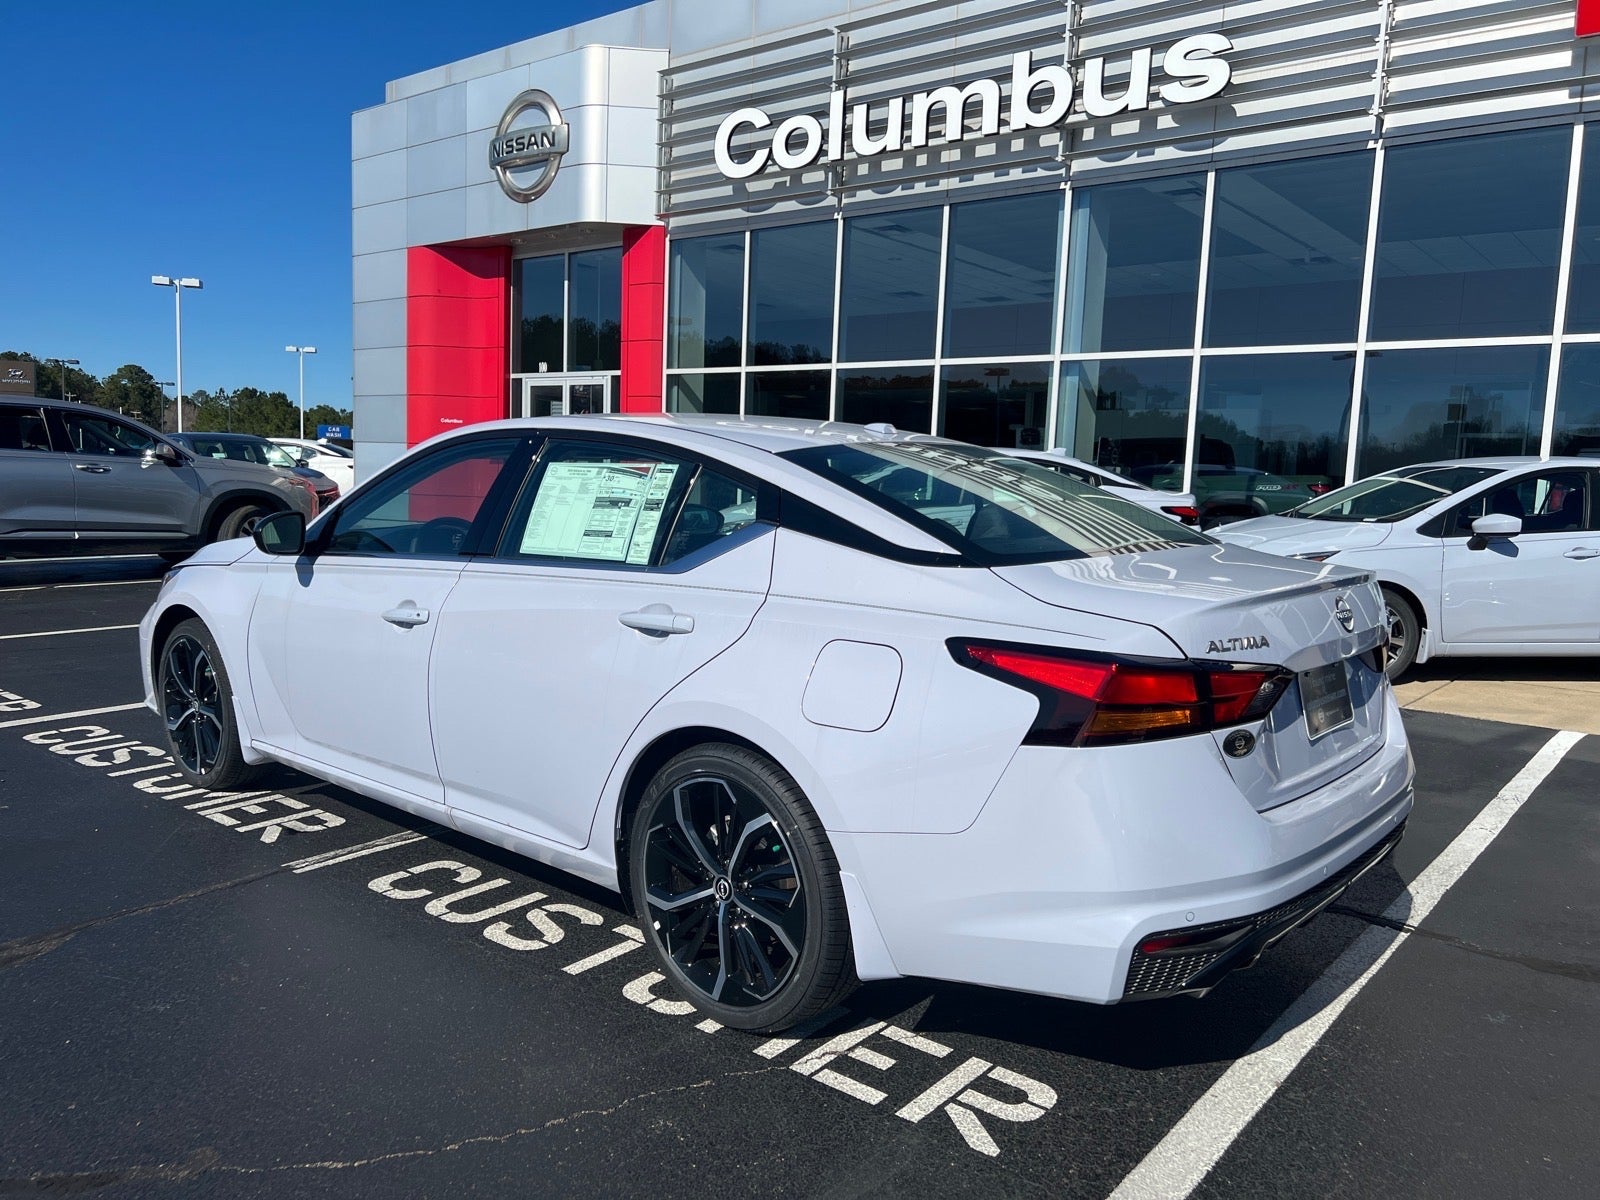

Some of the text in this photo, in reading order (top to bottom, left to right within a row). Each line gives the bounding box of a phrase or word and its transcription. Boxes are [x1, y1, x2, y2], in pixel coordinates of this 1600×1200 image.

[492, 131, 556, 158] NISSAN
[713, 32, 1235, 179] Columbus
[1206, 635, 1270, 654] ALTIMA
[367, 860, 1059, 1158] CUSTER
